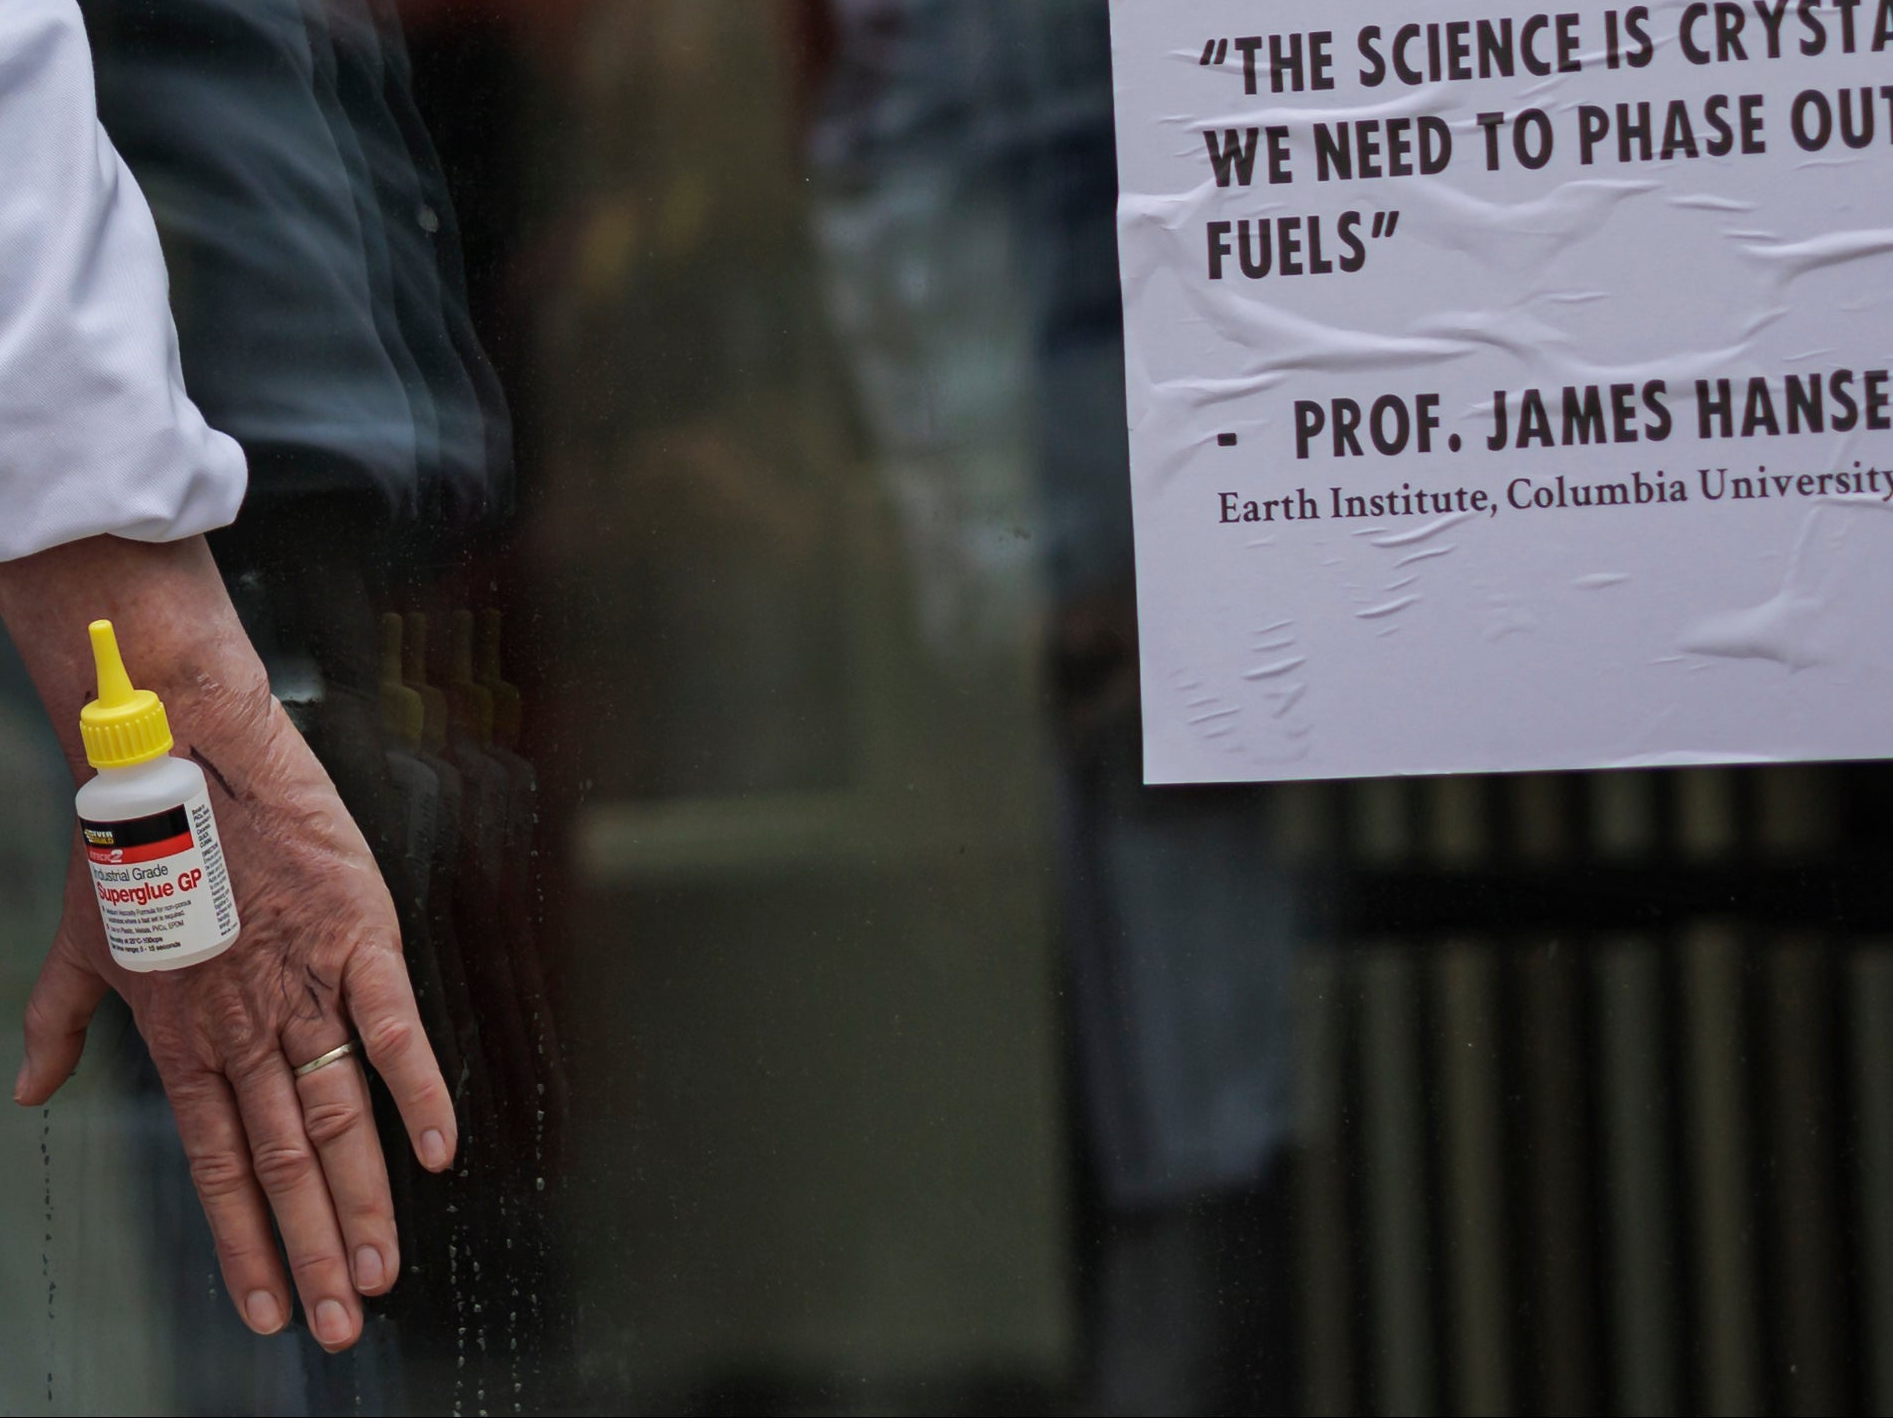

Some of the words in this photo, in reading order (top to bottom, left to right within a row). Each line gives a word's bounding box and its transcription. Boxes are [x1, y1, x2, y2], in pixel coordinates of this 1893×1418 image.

[1358, 13, 1582, 87] SCIENCE
[1605, 6, 1654, 69] IS
[1203, 126, 1292, 187] WE
[1313, 116, 1452, 181] NEED
[1477, 109, 1553, 171] TO
[1578, 94, 1765, 165] PHASE
[1294, 394, 1461, 459] PROF.
[1487, 380, 1672, 451] JAMES
[1695, 369, 1891, 439] HANSE
[1218, 488, 1320, 523] Earth
[1330, 483, 1497, 518] Institute,
[1507, 471, 1688, 509] Columbia
[1698, 461, 1893, 502] University
[97, 879, 174, 905] Superglue
[178, 868, 203, 892] GP
[131, 863, 169, 881] Grade
